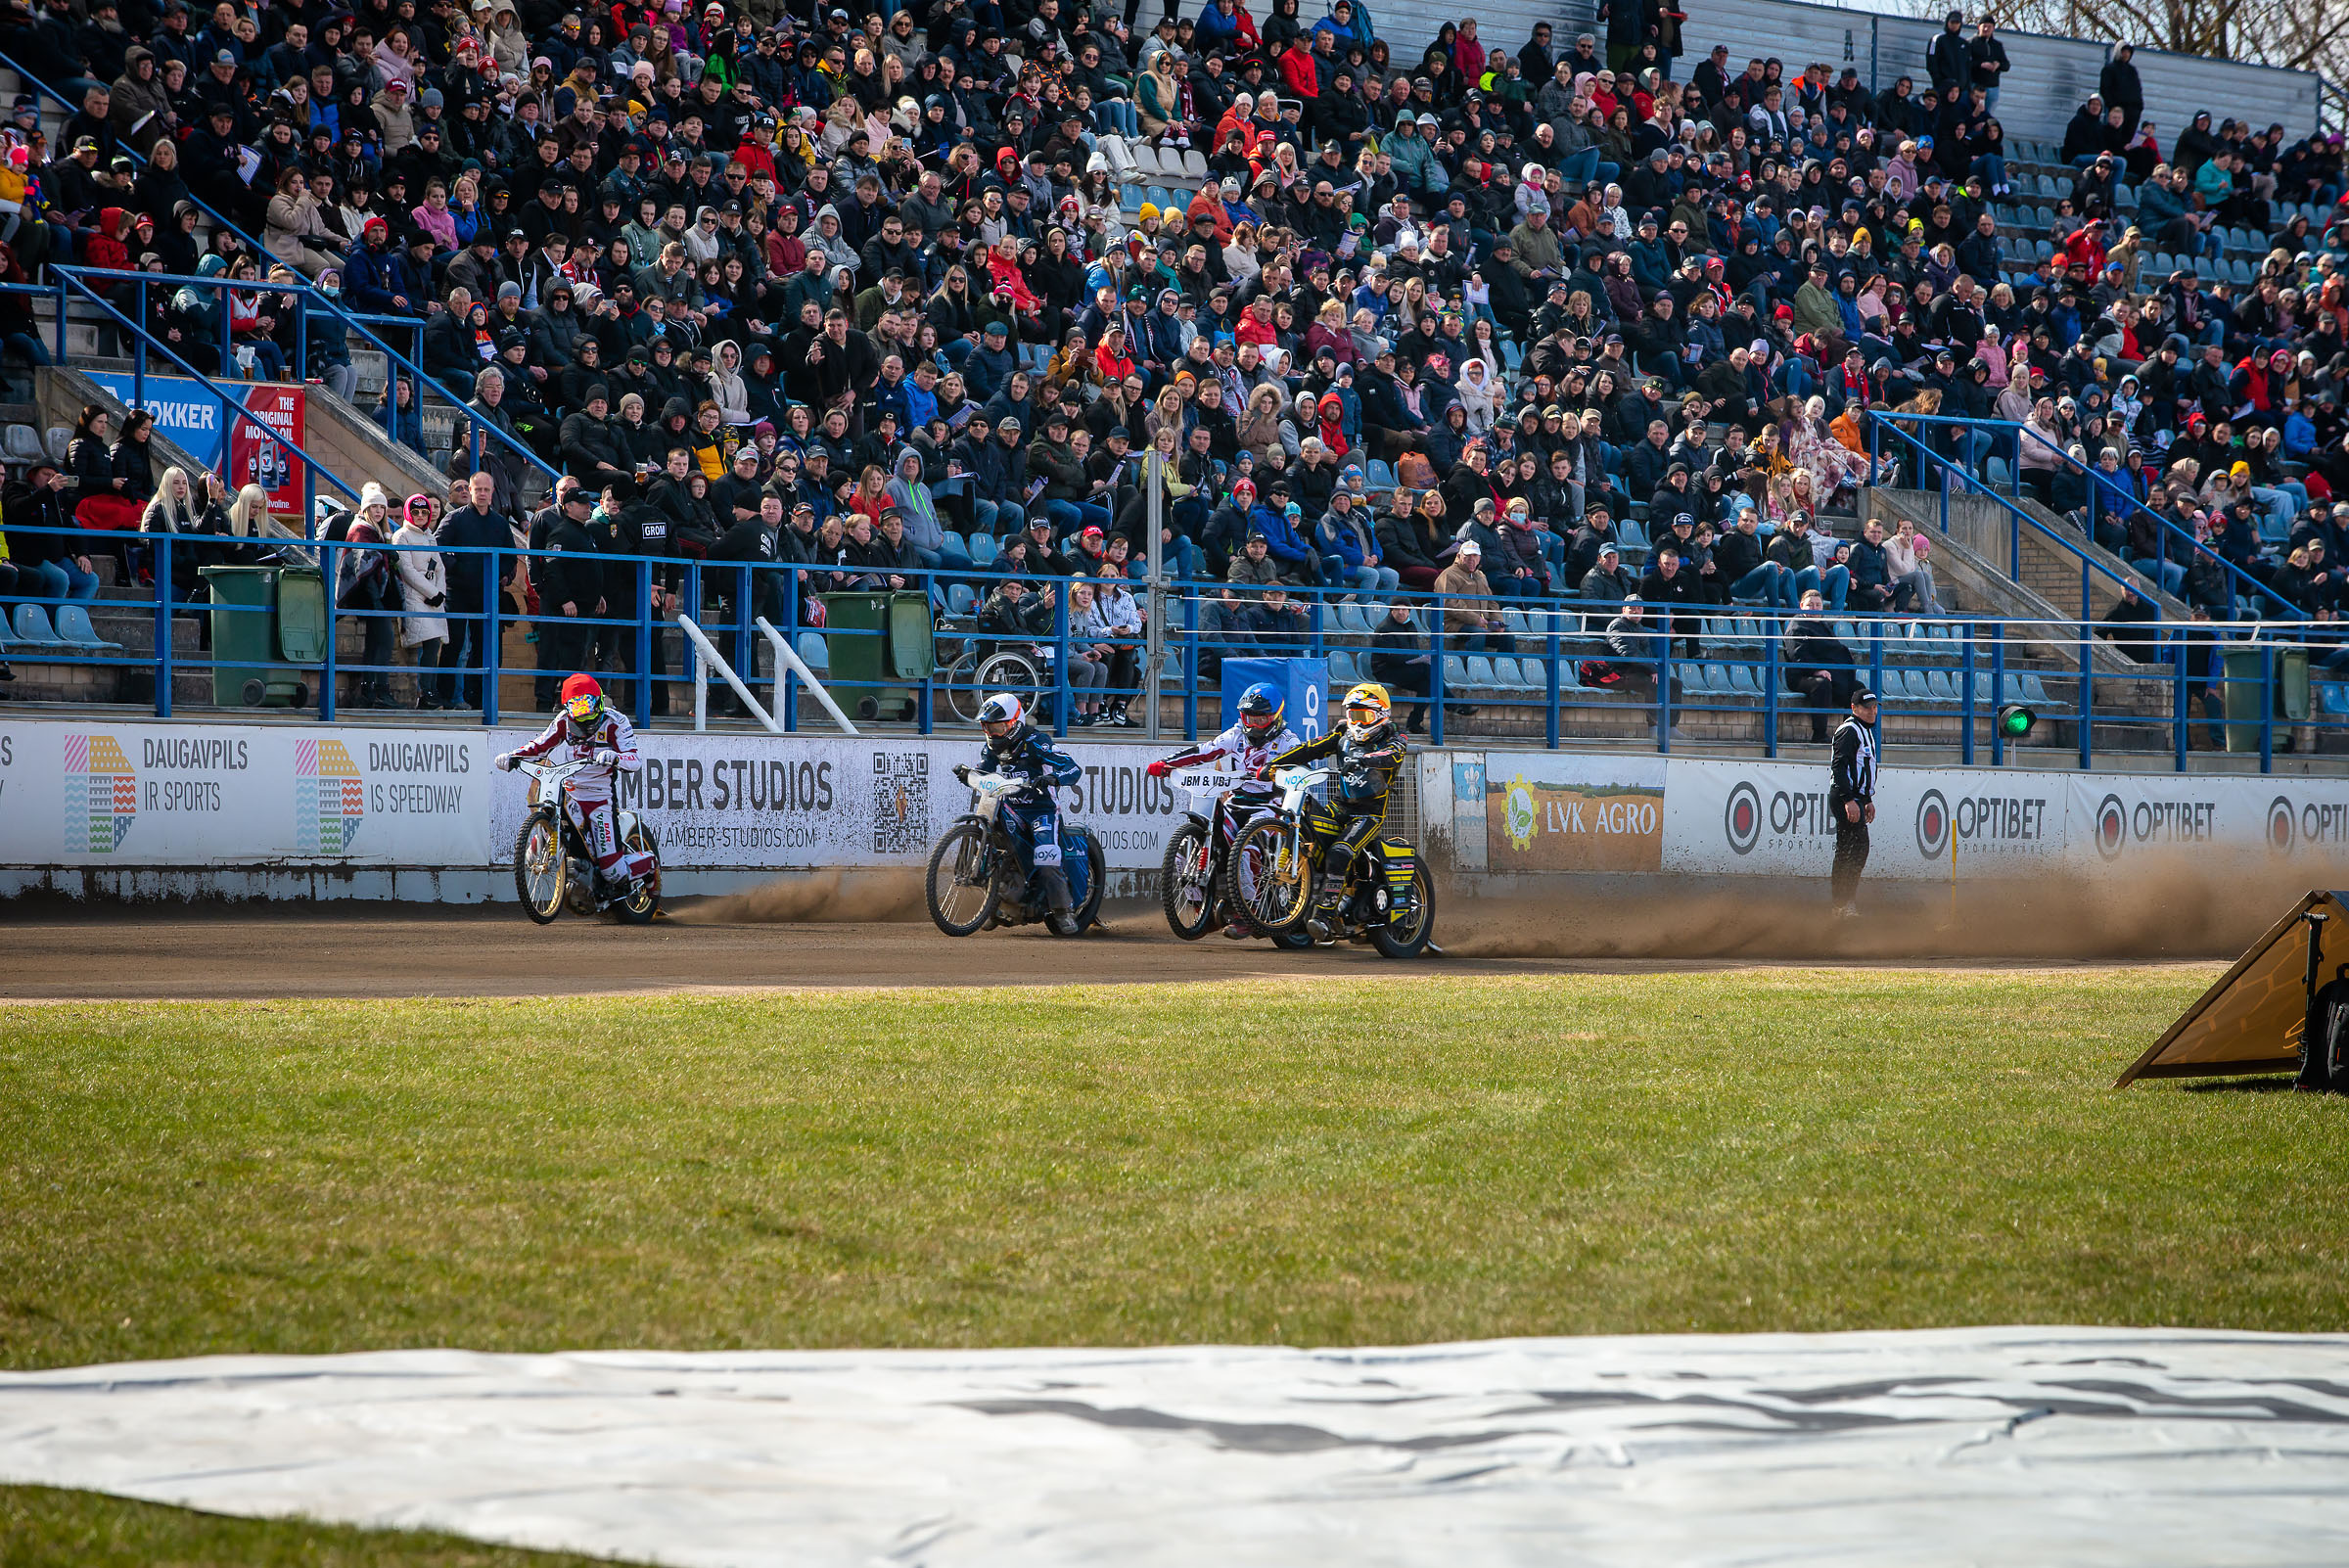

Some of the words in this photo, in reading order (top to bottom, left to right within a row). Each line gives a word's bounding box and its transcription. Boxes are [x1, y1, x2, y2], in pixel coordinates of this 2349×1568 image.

[125, 398, 216, 431] OKKER
[279, 396, 295, 411] THE
[266, 499, 291, 509] lvoline
[644, 525, 666, 536] GROM
[143, 737, 249, 771] DAUGAVPILS
[369, 742, 470, 774] DAUGAVPILS
[144, 782, 160, 812] IR
[164, 782, 221, 813] SPORTS
[620, 759, 705, 810] MBER
[712, 760, 833, 811] STUDIOS
[1068, 765, 1174, 815] STUDIOS
[1180, 775, 1201, 787] JBM
[1202, 776, 1211, 787] &
[1213, 775, 1231, 788] VBJ
[370, 785, 385, 813] IS
[390, 784, 462, 814] SPEEDWAY
[1770, 790, 1838, 836] OPTIB
[595, 811, 607, 853] VERONA
[1546, 801, 1587, 833] LVK
[1595, 802, 1657, 836] AGRO
[1957, 797, 2047, 840] OPTIBET
[2134, 801, 2216, 843] OPTIBET
[2302, 803, 2348, 844] OPTI
[650, 826, 816, 849] W.AMBER-STUDIOS.COM
